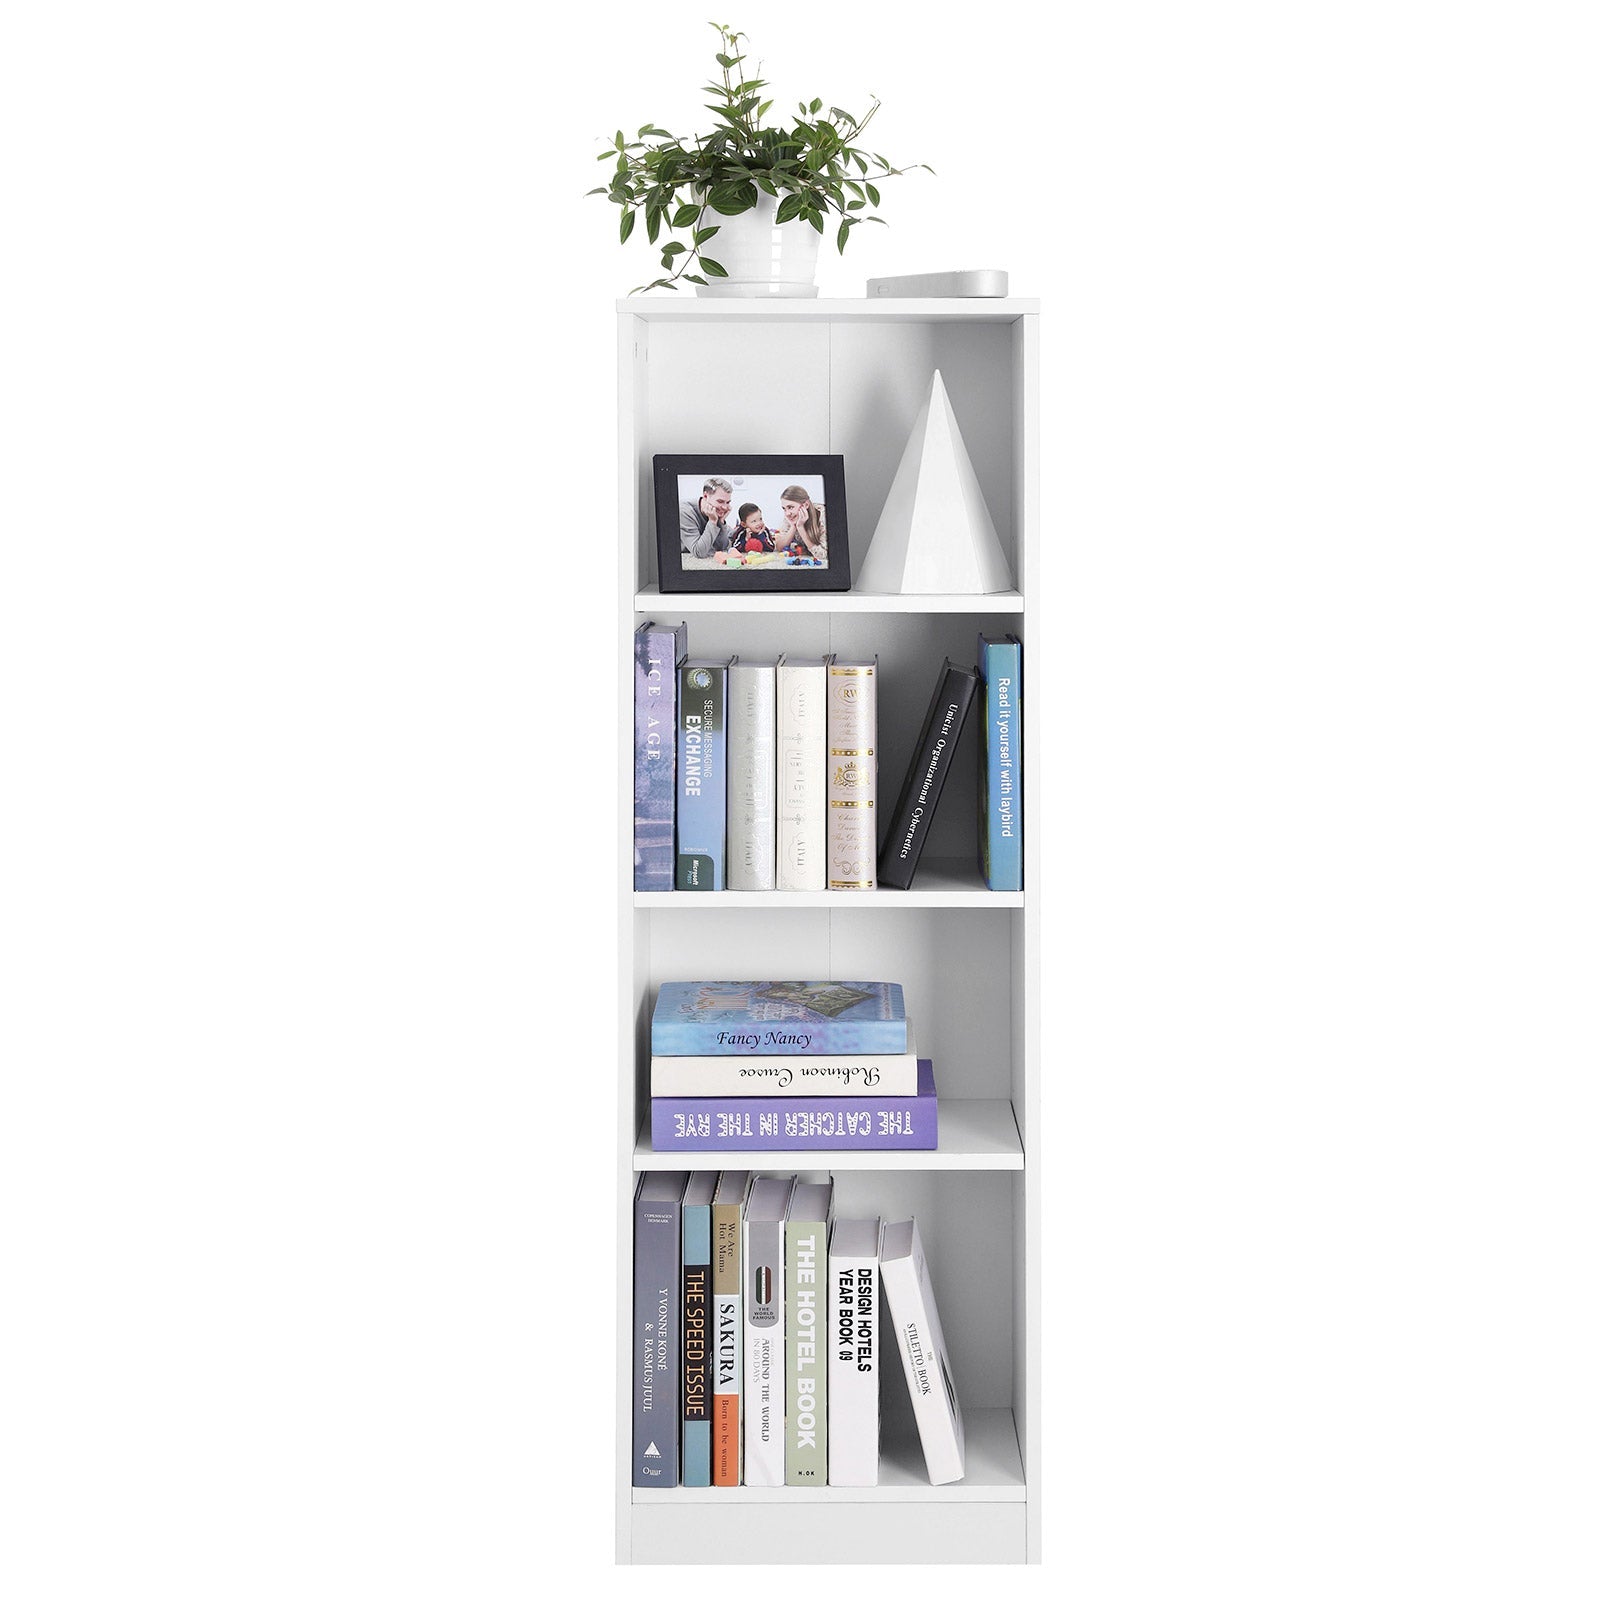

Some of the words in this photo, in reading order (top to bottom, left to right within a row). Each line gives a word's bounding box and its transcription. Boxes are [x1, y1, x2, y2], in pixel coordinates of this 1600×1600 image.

[648, 659, 661, 696] ICE
[998, 678, 1011, 707] Read
[704, 700, 713, 730] SECURE
[941, 704, 958, 735] Unicist
[999, 710, 1012, 719] it
[647, 716, 661, 761] AGE
[997, 720, 1012, 768] yourself
[686, 715, 702, 796] EXCHANGE
[703, 732, 713, 778] MESSAGING
[918, 738, 947, 804] Organizational
[1000, 770, 1012, 794] with
[998, 797, 1014, 837] laybird
[899, 807, 924, 860] Cybernetics
[716, 1031, 760, 1048] Fancy
[765, 1031, 812, 1048] Nancy
[739, 1068, 794, 1088] Crusoe
[800, 1066, 880, 1086] Robinson
[674, 1113, 710, 1138] RYE
[716, 1113, 753, 1137] THE
[759, 1112, 778, 1137] IN
[785, 1111, 871, 1137] CATCHER
[877, 1111, 914, 1136] THE
[728, 1222, 736, 1238] We
[798, 1235, 815, 1284] THE
[658, 1288, 668, 1296] Y
[686, 1270, 704, 1304] THE
[840, 1268, 854, 1304] YEAR
[858, 1268, 872, 1316] DESIGN
[645, 1322, 654, 1331] &
[658, 1298, 668, 1338] VONNE
[798, 1290, 816, 1372] HOTEL
[840, 1309, 854, 1346] BOOK
[686, 1308, 704, 1360] SPEED
[720, 1304, 735, 1386] SAKURA
[753, 1338, 760, 1348] IN
[858, 1320, 872, 1372] HOTELS
[644, 1338, 654, 1383] RASMUS
[658, 1340, 668, 1371] KONÉ
[753, 1350, 760, 1360] 80
[762, 1338, 770, 1380] AROUND
[840, 1350, 853, 1361] 09
[906, 1322, 924, 1367] STILETTO
[916, 1370, 932, 1396] BOOK
[642, 1384, 654, 1412] JUUL
[686, 1364, 704, 1416] ISSUE
[762, 1384, 770, 1403] THE
[721, 1400, 729, 1419] Born
[762, 1406, 770, 1442] WORLD
[798, 1378, 816, 1448] BOOK
[721, 1423, 728, 1432] to
[721, 1435, 729, 1445] be
